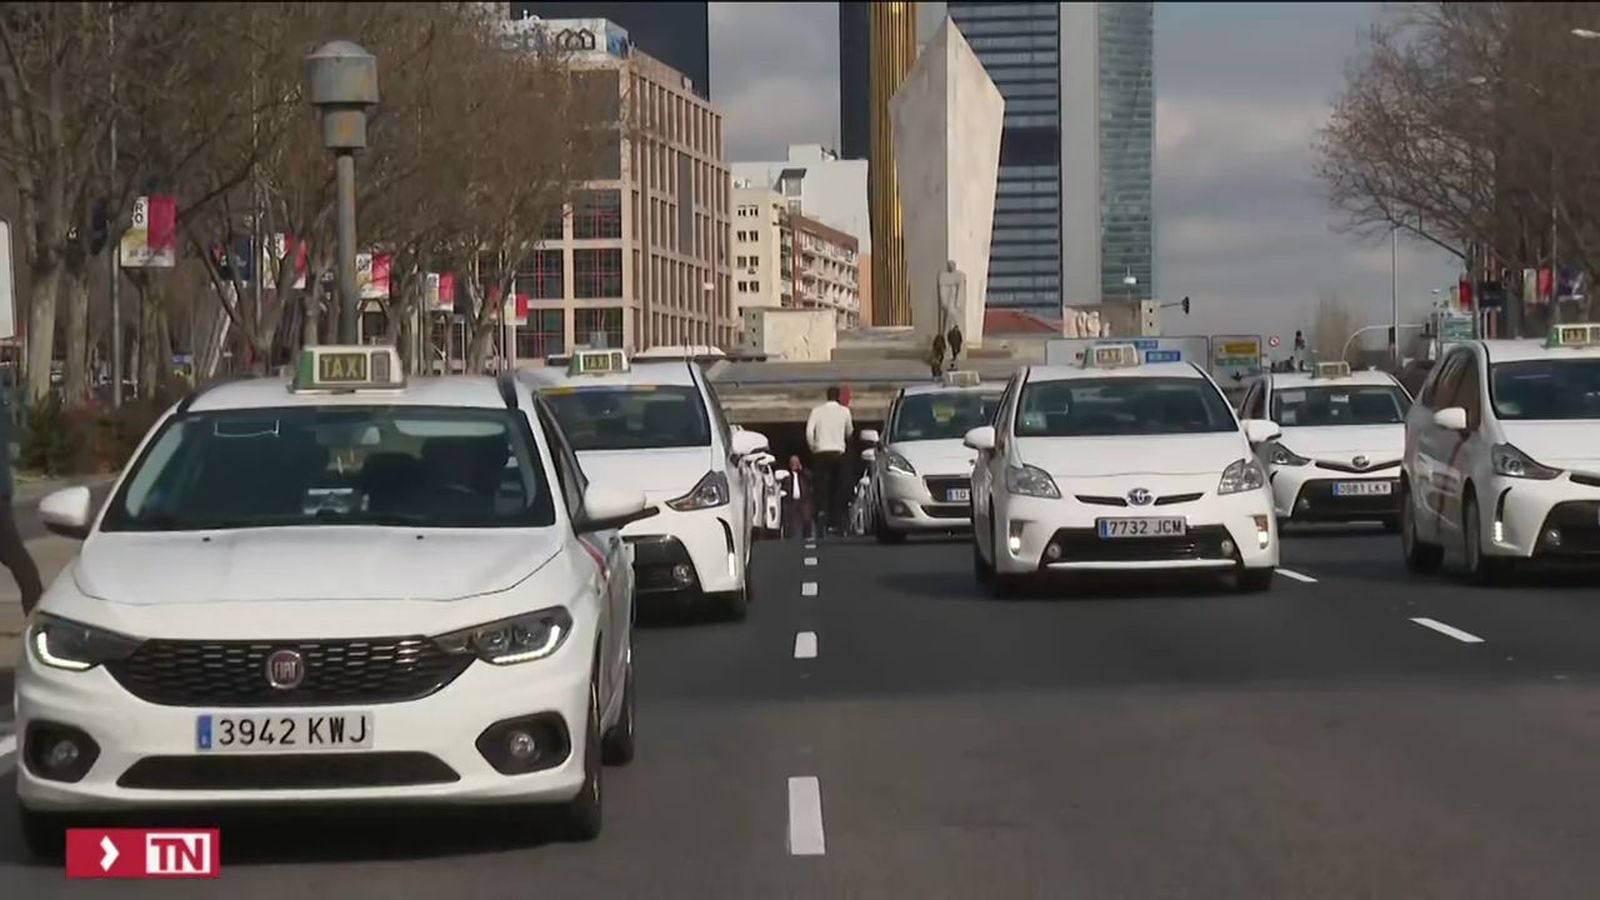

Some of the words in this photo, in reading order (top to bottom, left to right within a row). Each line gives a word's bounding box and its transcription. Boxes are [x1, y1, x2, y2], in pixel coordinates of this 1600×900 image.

[321, 356, 365, 378] TAXI
[584, 356, 609, 369] TAXI
[1110, 521, 1148, 535] 7732
[1154, 519, 1182, 534] JCM
[274, 661, 296, 679] FIAT
[219, 718, 296, 745] 3942
[308, 715, 366, 744] KWJ
